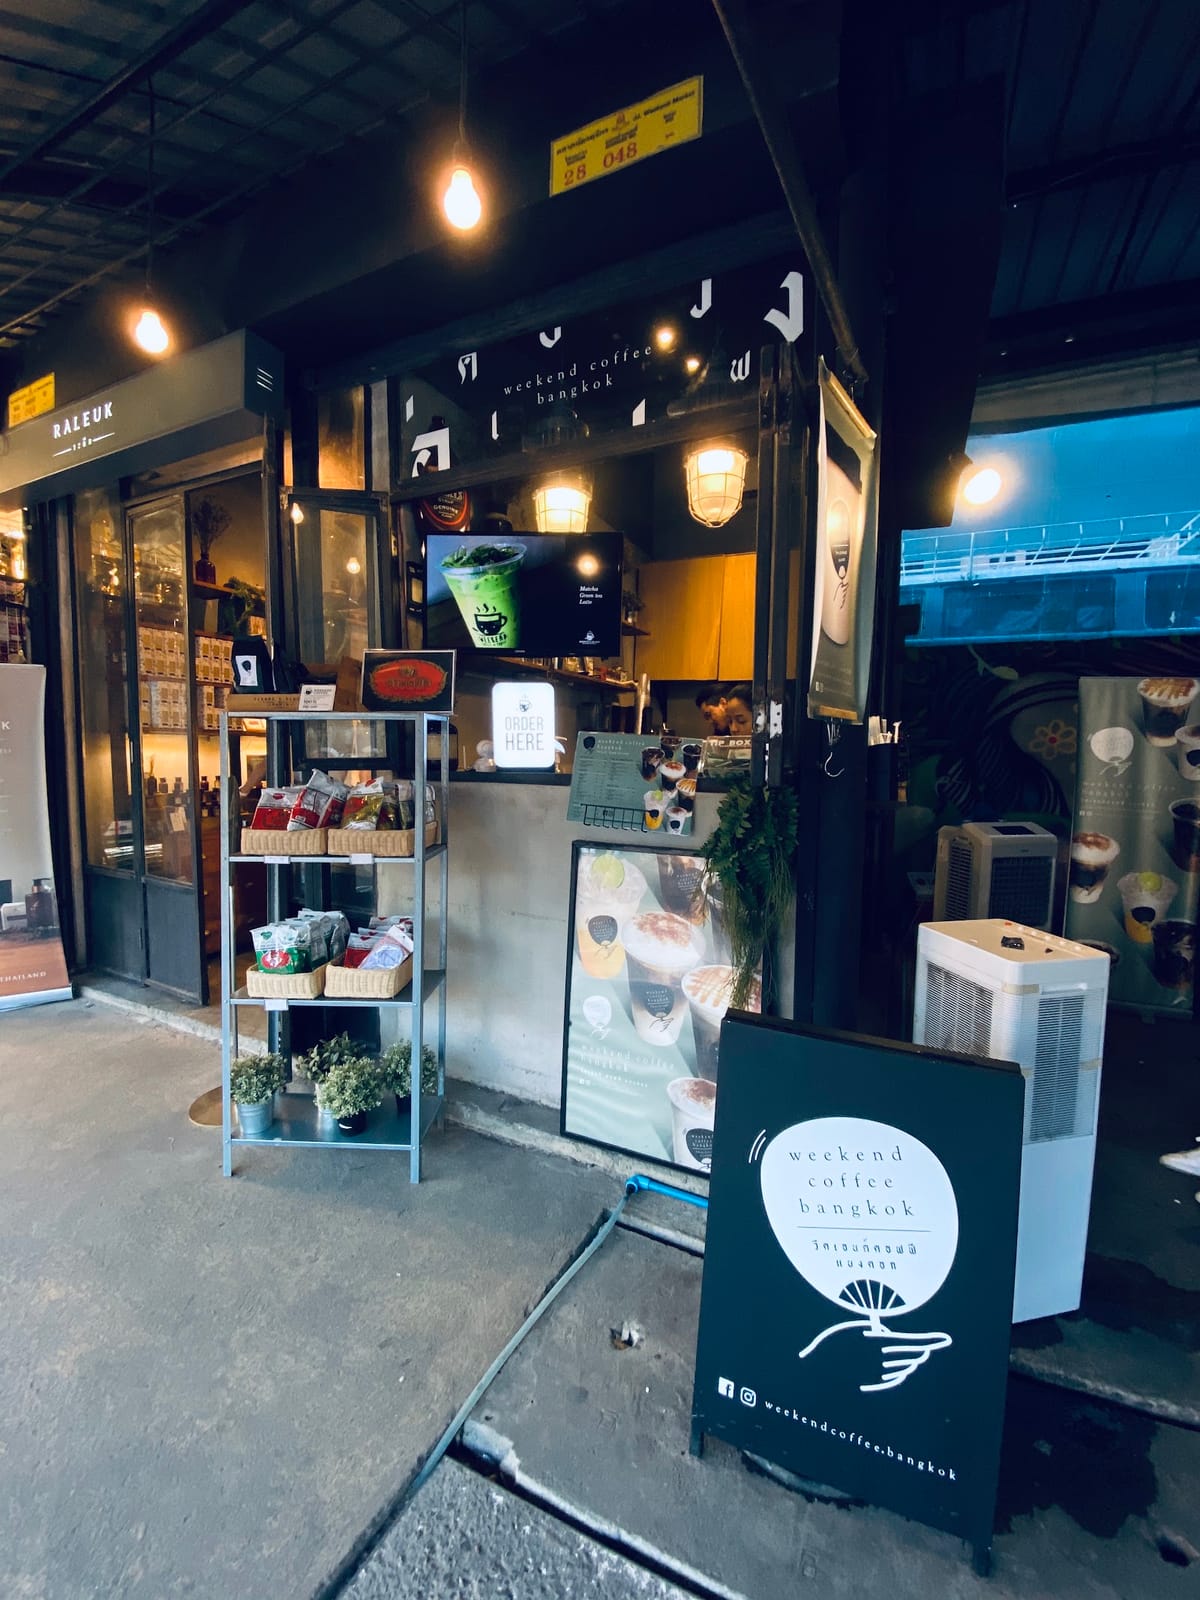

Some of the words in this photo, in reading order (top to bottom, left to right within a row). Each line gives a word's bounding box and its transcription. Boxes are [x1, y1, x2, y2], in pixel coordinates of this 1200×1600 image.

[564, 164, 586, 186] 28
[603, 142, 638, 168] 048
[503, 363, 577, 396] weekend
[590, 346, 652, 371] coffee
[537, 373, 613, 404] bangkok
[53, 401, 113, 439] RALEUK
[505, 716, 544, 731] ORDER
[505, 733, 545, 751] HERE
[709, 739, 725, 747] TIP
[729, 739, 751, 747] BOX
[789, 1145, 902, 1161] weekend
[808, 1172, 895, 1188] coffee
[799, 1198, 915, 1218] bangkok
[765, 1400, 957, 1481] weekendcoffee.bangkok
